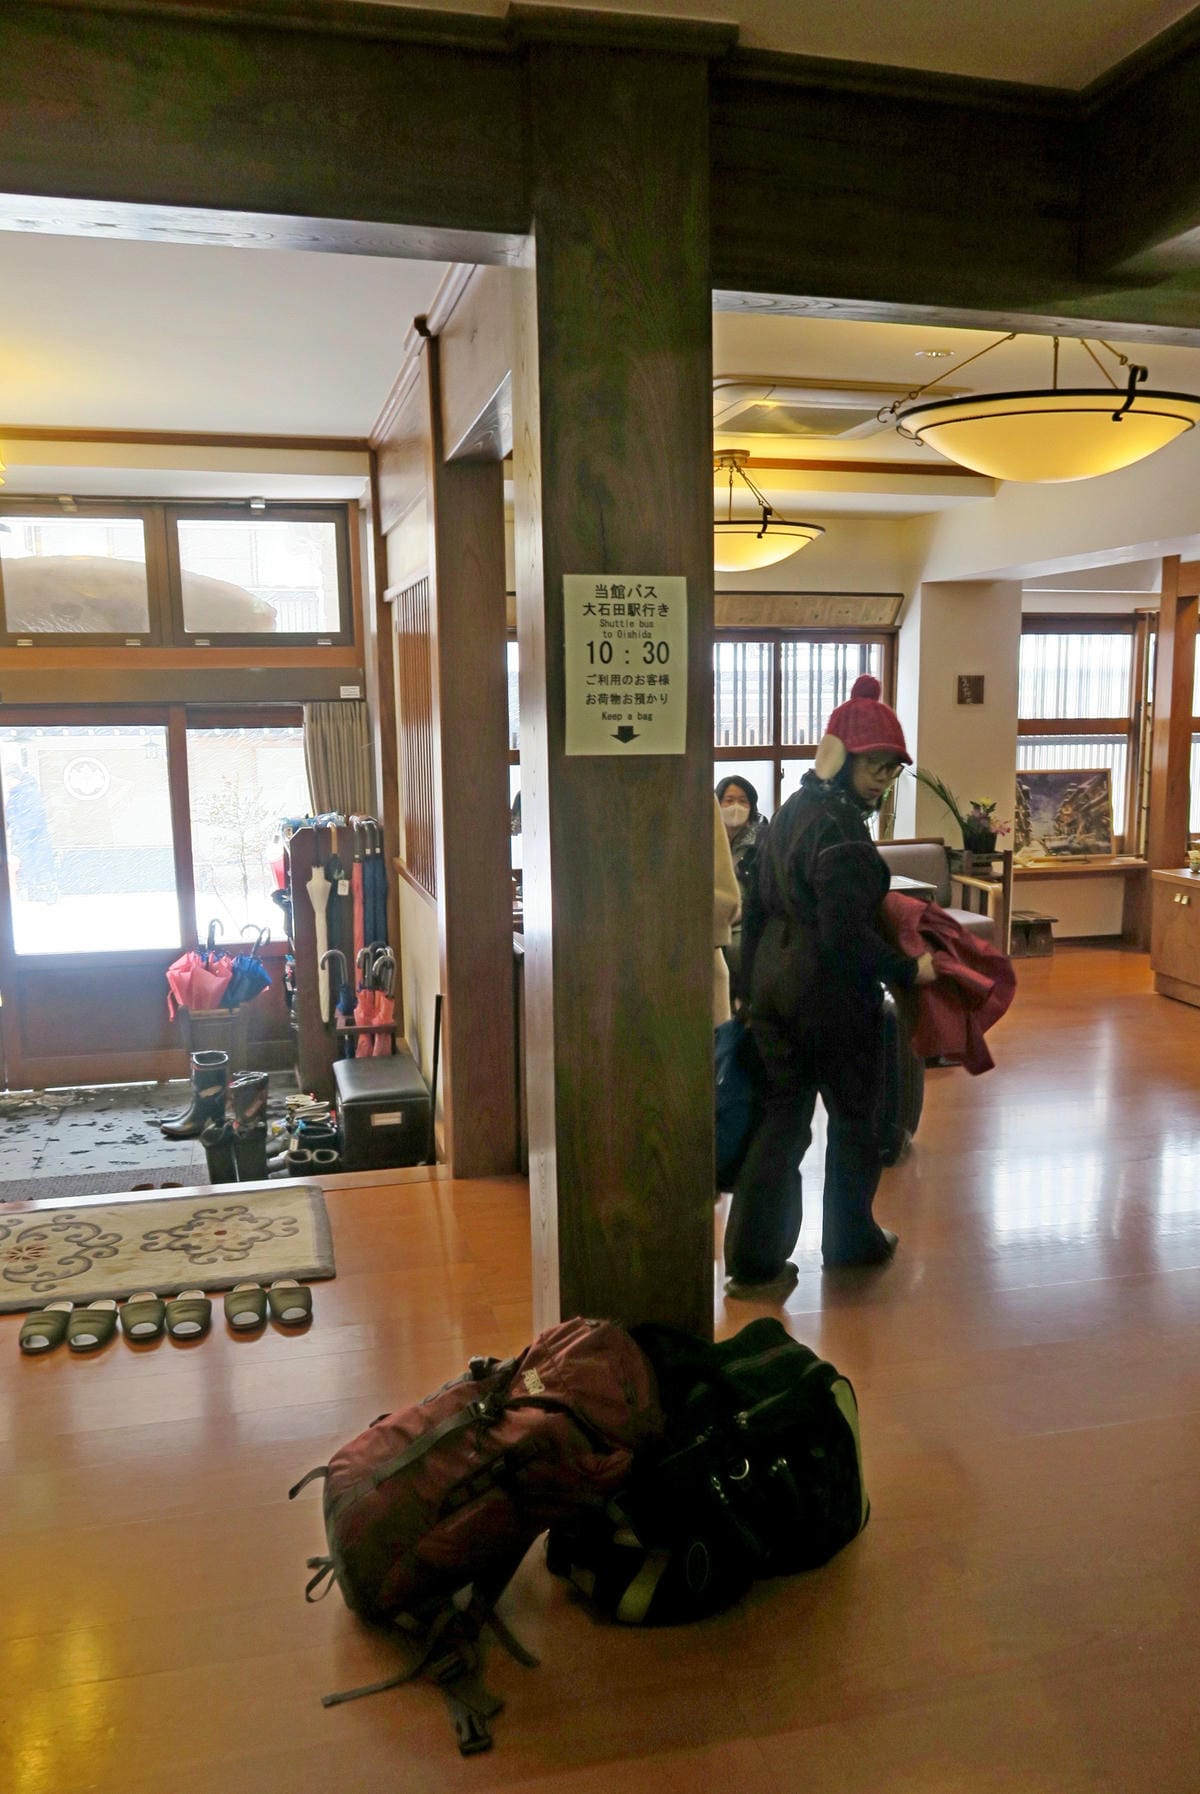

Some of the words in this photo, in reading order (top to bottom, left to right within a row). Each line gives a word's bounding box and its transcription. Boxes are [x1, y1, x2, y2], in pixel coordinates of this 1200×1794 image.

[595, 584, 658, 600] 当館バス
[582, 602, 670, 618] 大石田駅行き
[600, 619, 635, 628] Shuttle
[639, 619, 654, 628] bus
[603, 630, 613, 639] to
[617, 630, 652, 639] Oishida
[586, 674, 670, 686] ご利用のお客様
[586, 693, 669, 705] お荷物お預かり
[602, 712, 623, 721] Keep
[637, 712, 653, 721] bag
